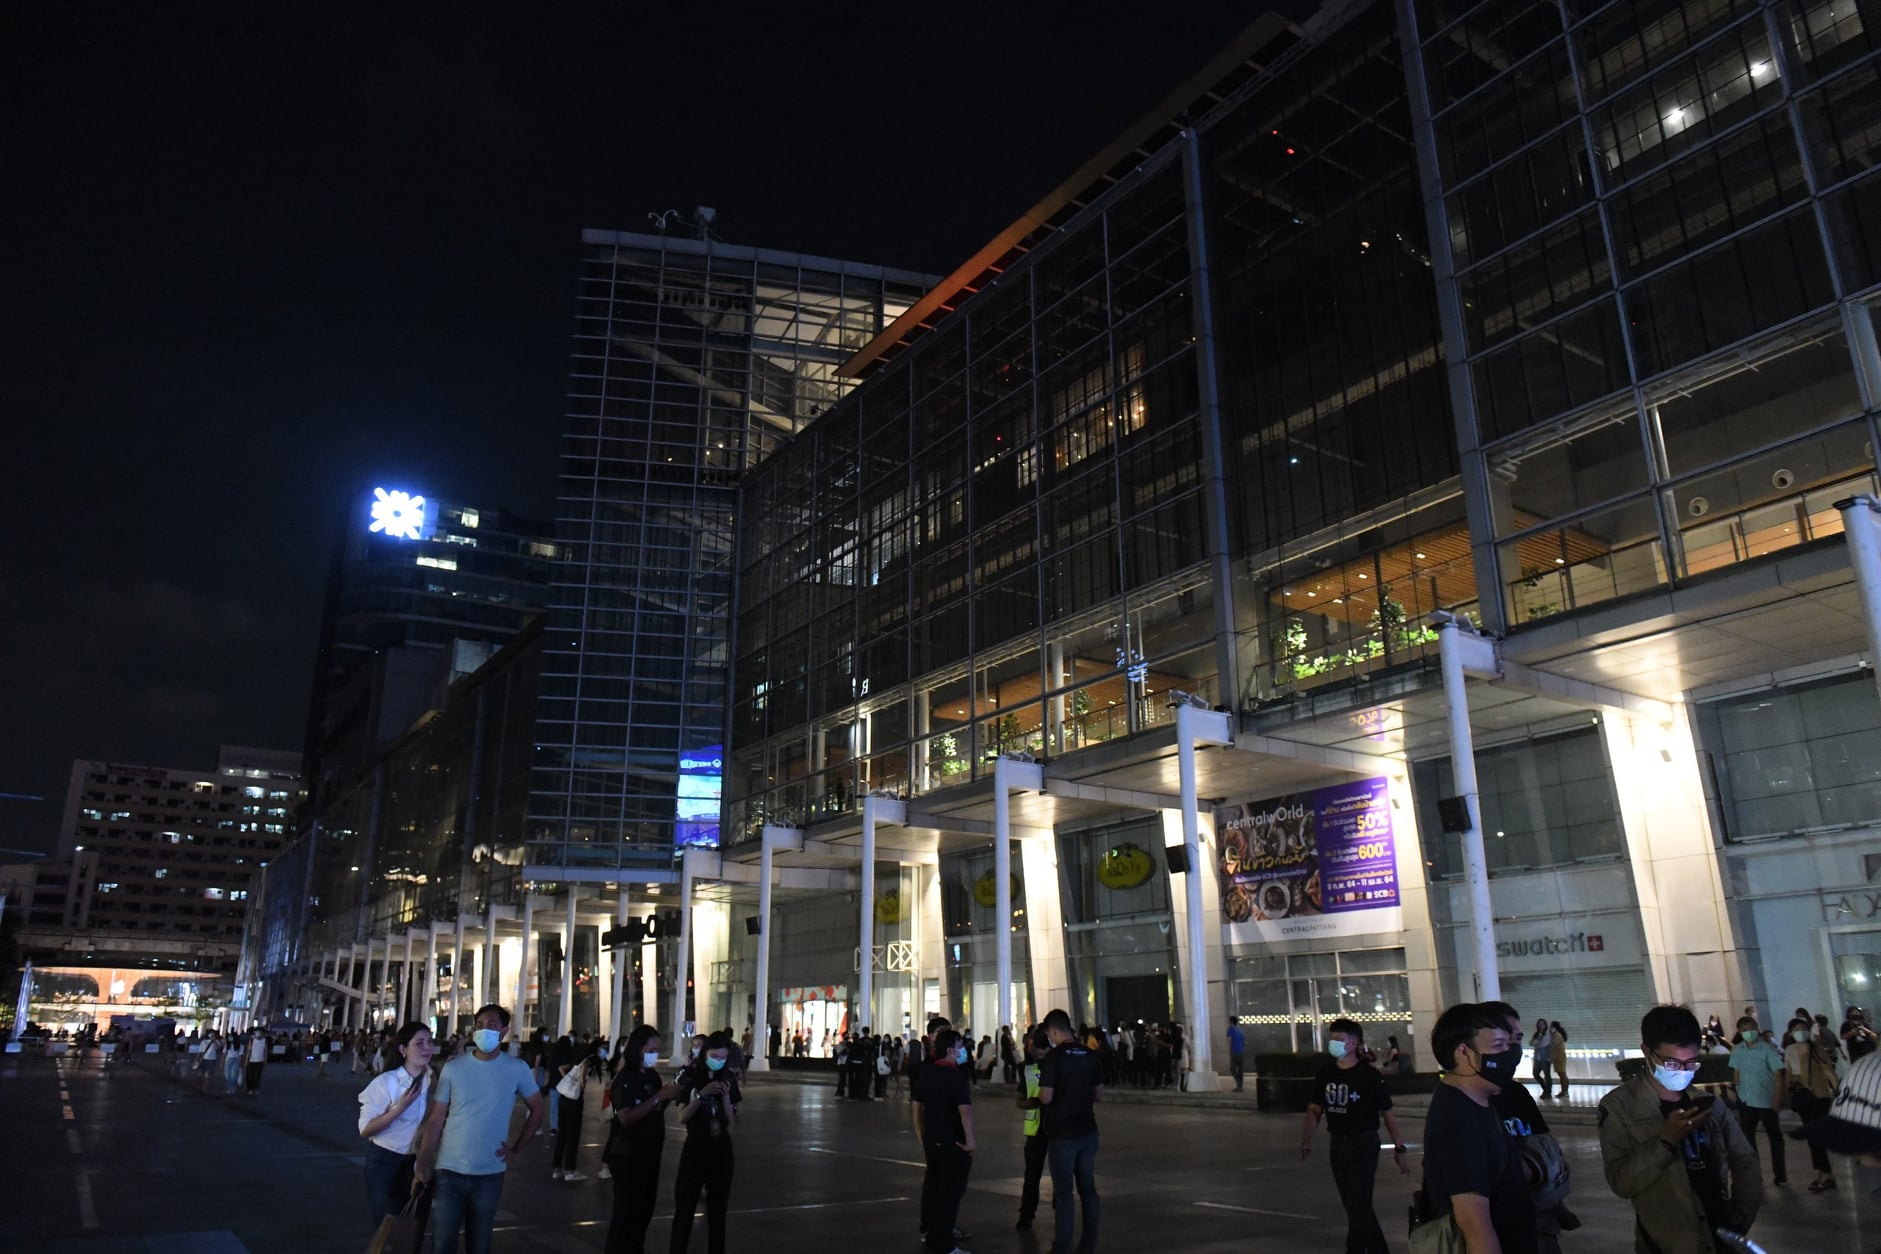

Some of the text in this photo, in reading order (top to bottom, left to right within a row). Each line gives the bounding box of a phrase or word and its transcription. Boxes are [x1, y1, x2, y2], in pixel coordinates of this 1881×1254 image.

[1356, 810, 1389, 831] 50%
[1358, 842, 1384, 860] 600
[1373, 889, 1389, 898] SCB
[1496, 932, 1585, 958] swatch
[1325, 1082, 1361, 1106] 60+
